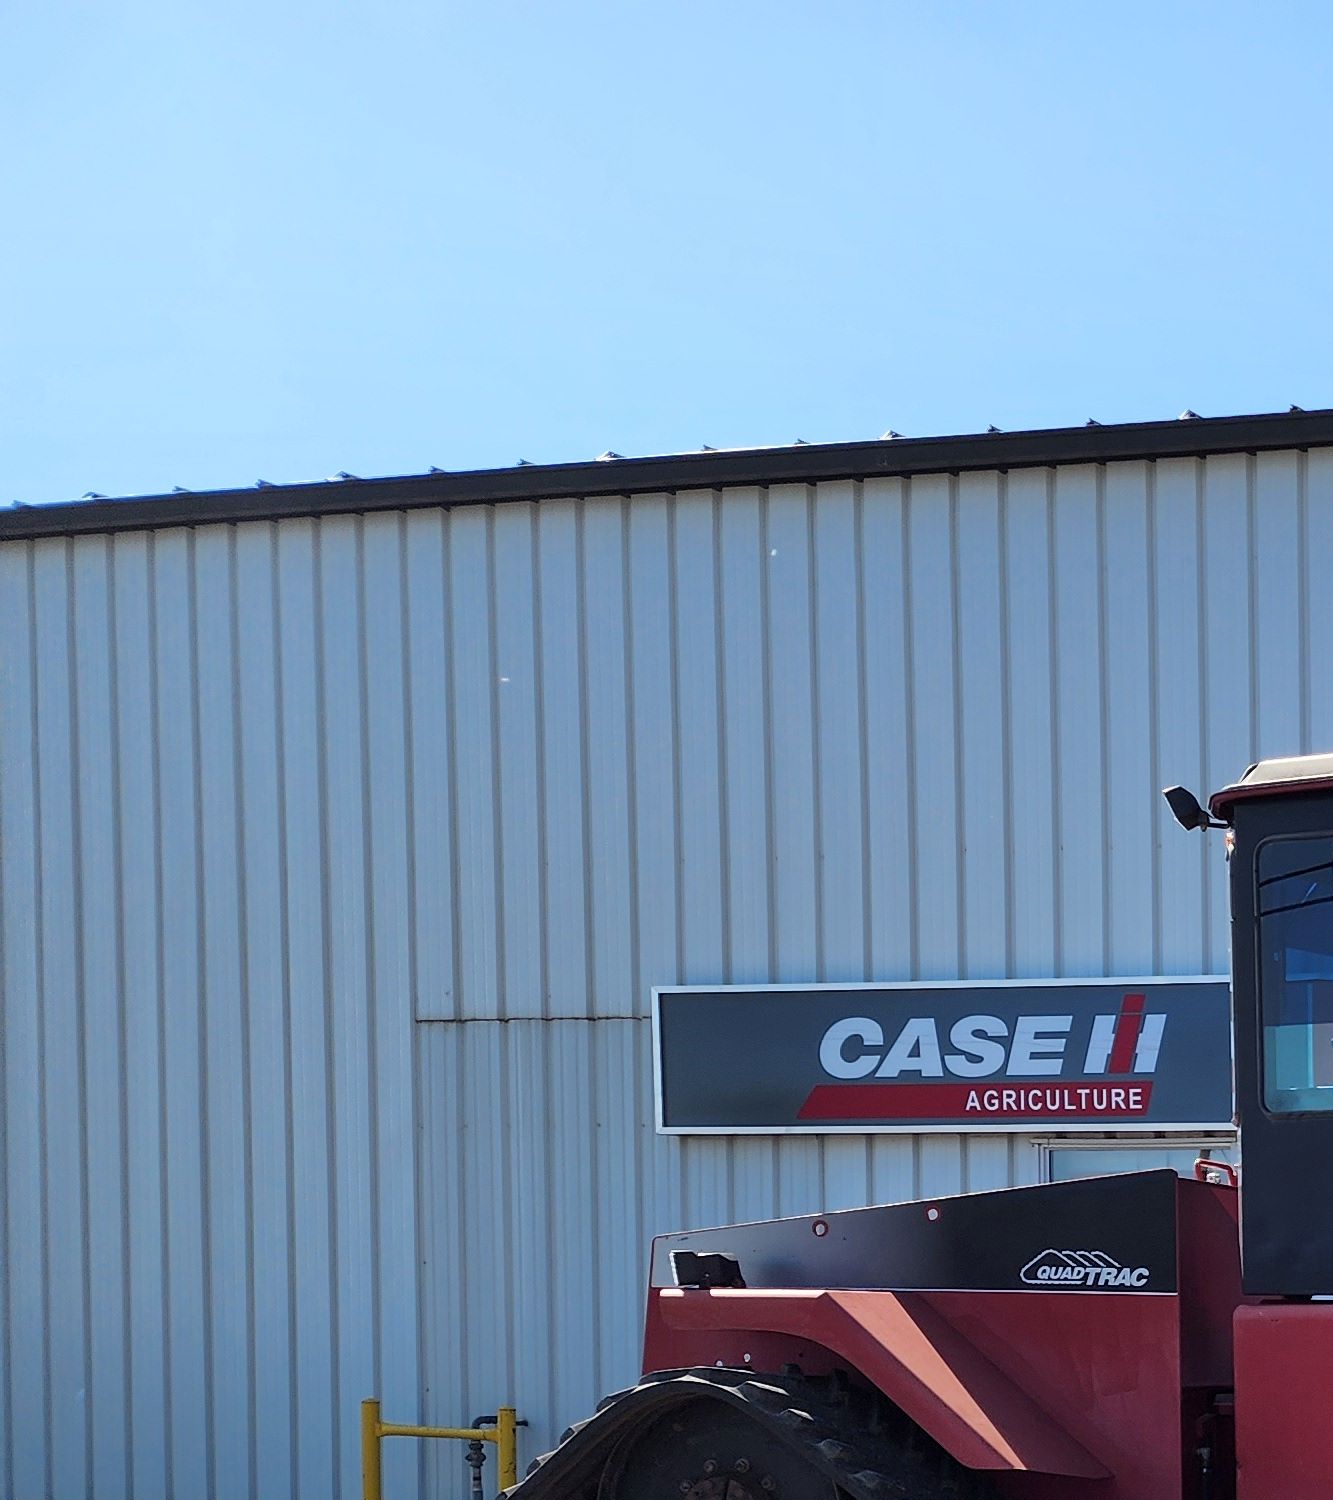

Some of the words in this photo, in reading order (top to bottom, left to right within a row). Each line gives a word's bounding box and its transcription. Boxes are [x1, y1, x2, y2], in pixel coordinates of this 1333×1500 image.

[819, 1015, 1073, 1079] CASE
[965, 1088, 1143, 1111] AGRICULTURE
[1036, 1265, 1150, 1287] QUADTRAC
